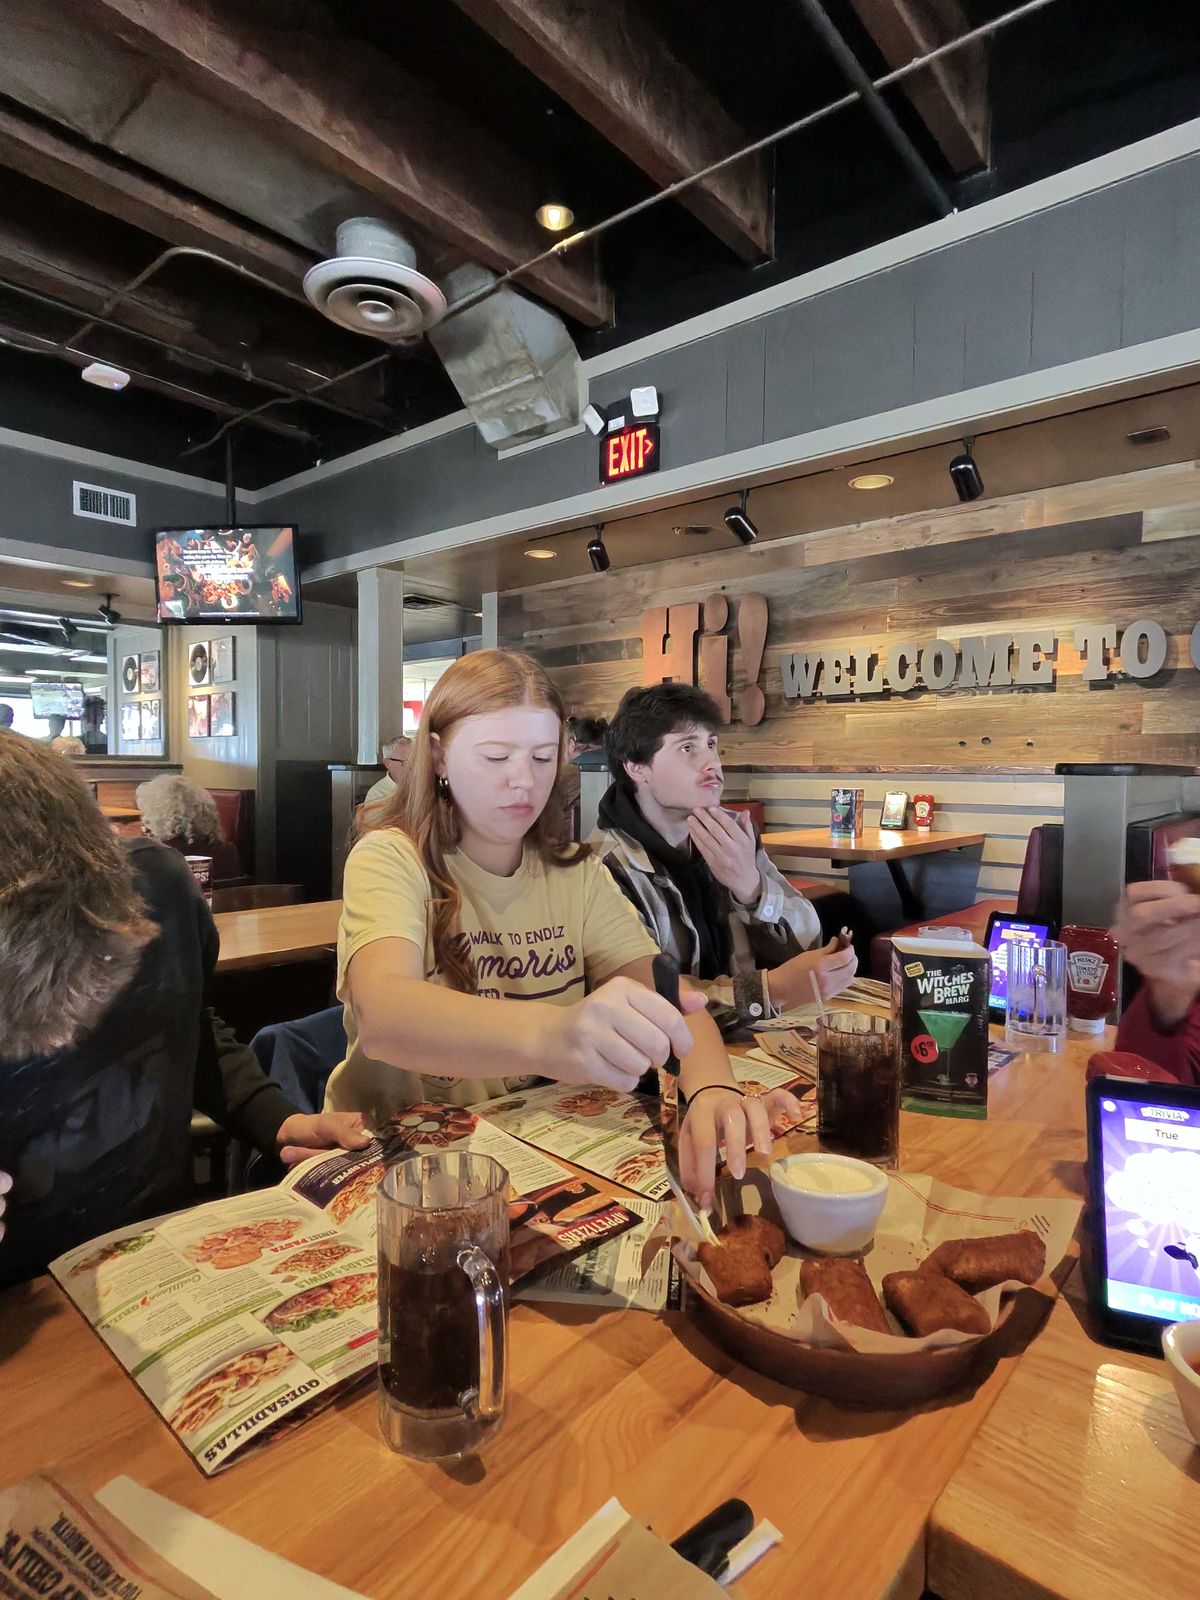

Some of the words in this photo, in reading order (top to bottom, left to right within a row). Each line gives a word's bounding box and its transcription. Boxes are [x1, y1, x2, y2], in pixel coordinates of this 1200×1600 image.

[608, 428, 647, 477] EXIT
[641, 592, 768, 726] Hi!
[781, 629, 1055, 698] WELCOME
[1074, 619, 1167, 680] TO
[470, 931, 503, 946] WALK
[508, 932, 521, 945] TO
[917, 972, 974, 994] WITCHES
[926, 969, 942, 977] THE
[934, 984, 970, 1004] BREW
[945, 995, 969, 1005] MARG
[1150, 1109, 1183, 1120] TRIVIA
[1155, 1129, 1178, 1140] True
[556, 1211, 630, 1247] APPETIZERS
[294, 1270, 335, 1289] BOWLS
[204, 1378, 320, 1462] QUESADILLAS
